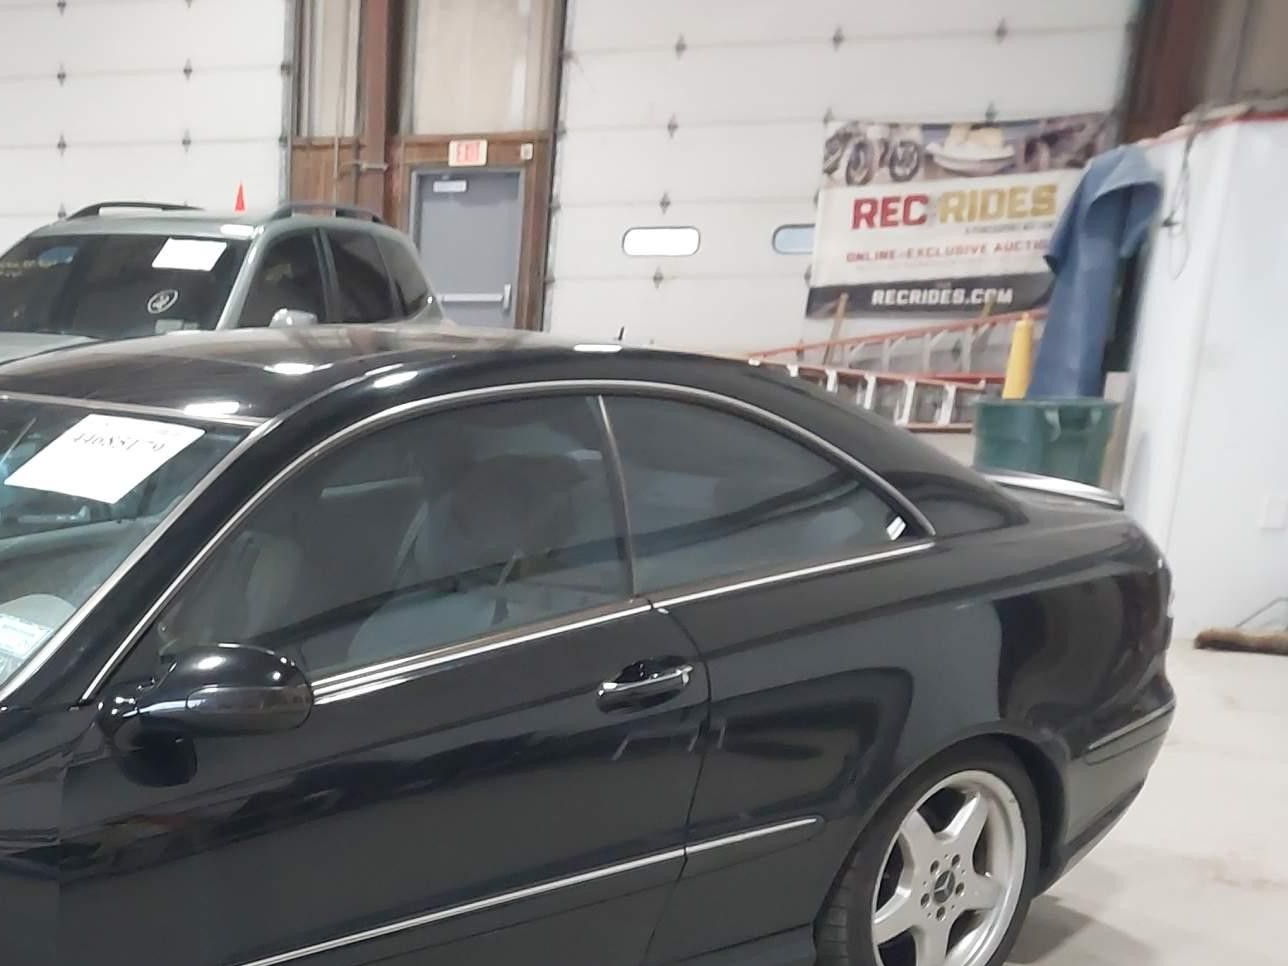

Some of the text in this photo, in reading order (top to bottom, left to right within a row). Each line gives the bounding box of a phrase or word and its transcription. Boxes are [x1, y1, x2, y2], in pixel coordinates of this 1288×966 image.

[851, 183, 1058, 230] REC RIDES
[871, 288, 1013, 305] RECRIDES.COM
